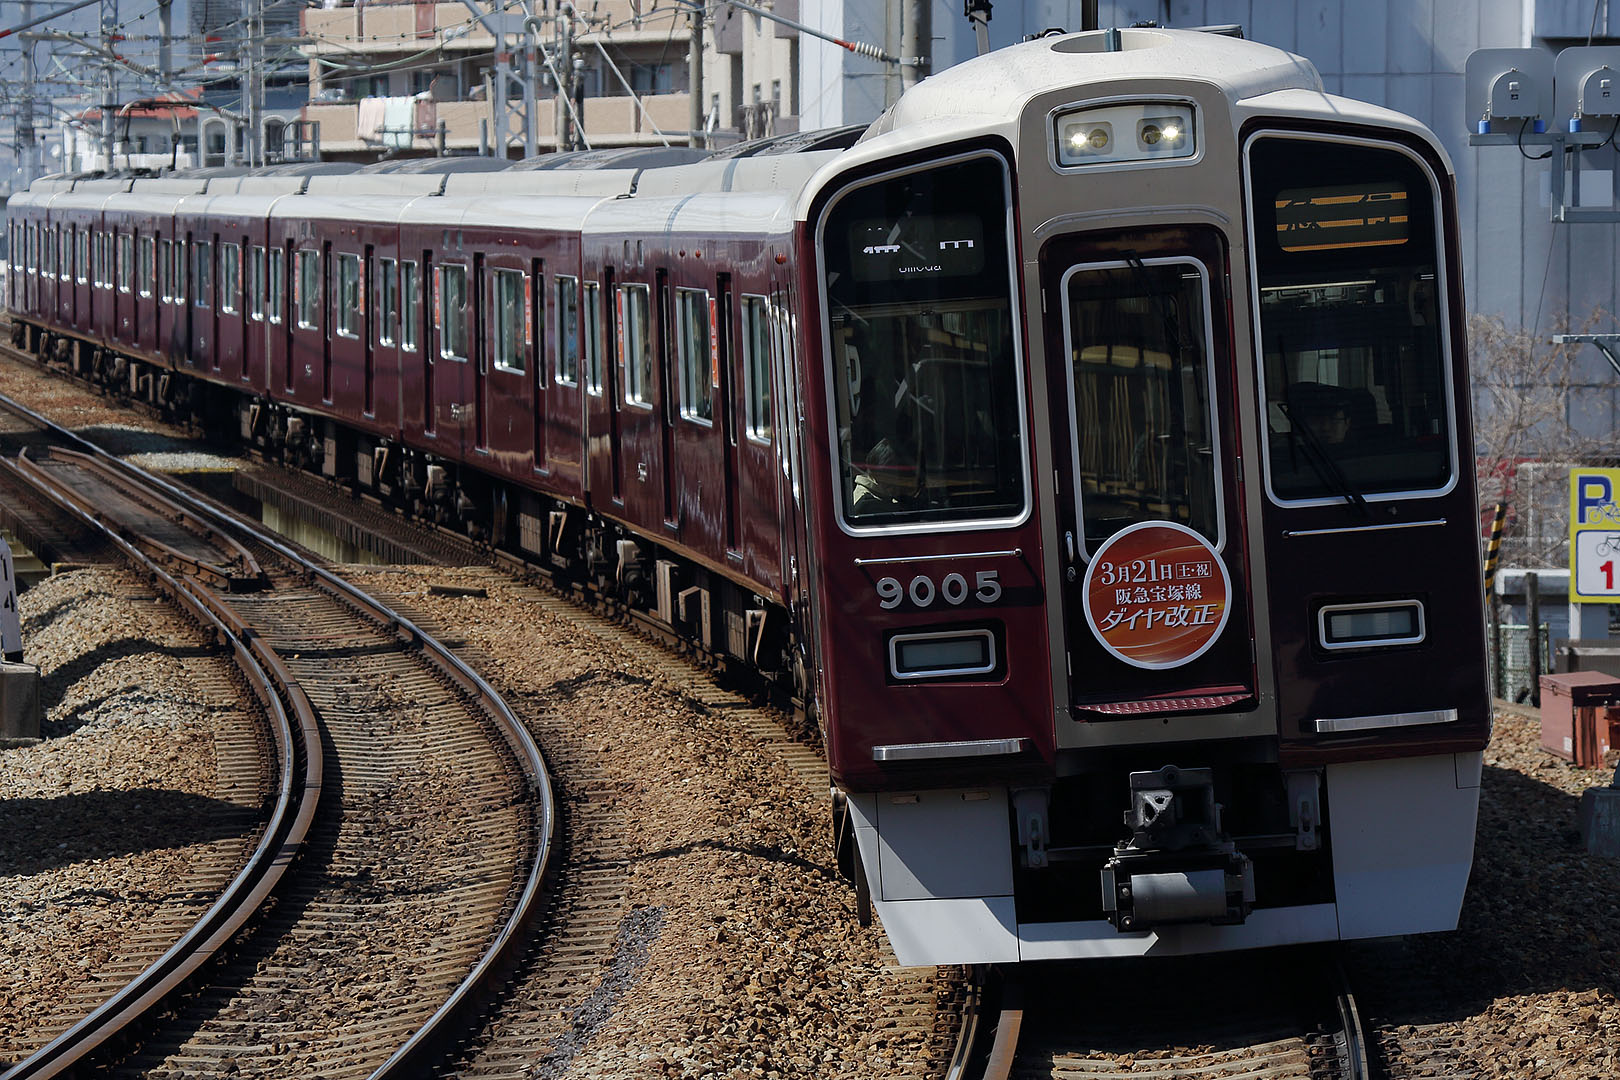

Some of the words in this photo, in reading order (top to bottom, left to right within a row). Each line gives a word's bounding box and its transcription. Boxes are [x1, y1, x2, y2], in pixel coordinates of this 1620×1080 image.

[1578, 475, 1612, 524] P
[876, 570, 1002, 609] 9005
[1115, 583, 1203, 606] 阪急宝塚線
[1100, 603, 1218, 632] ダイヤ改正
